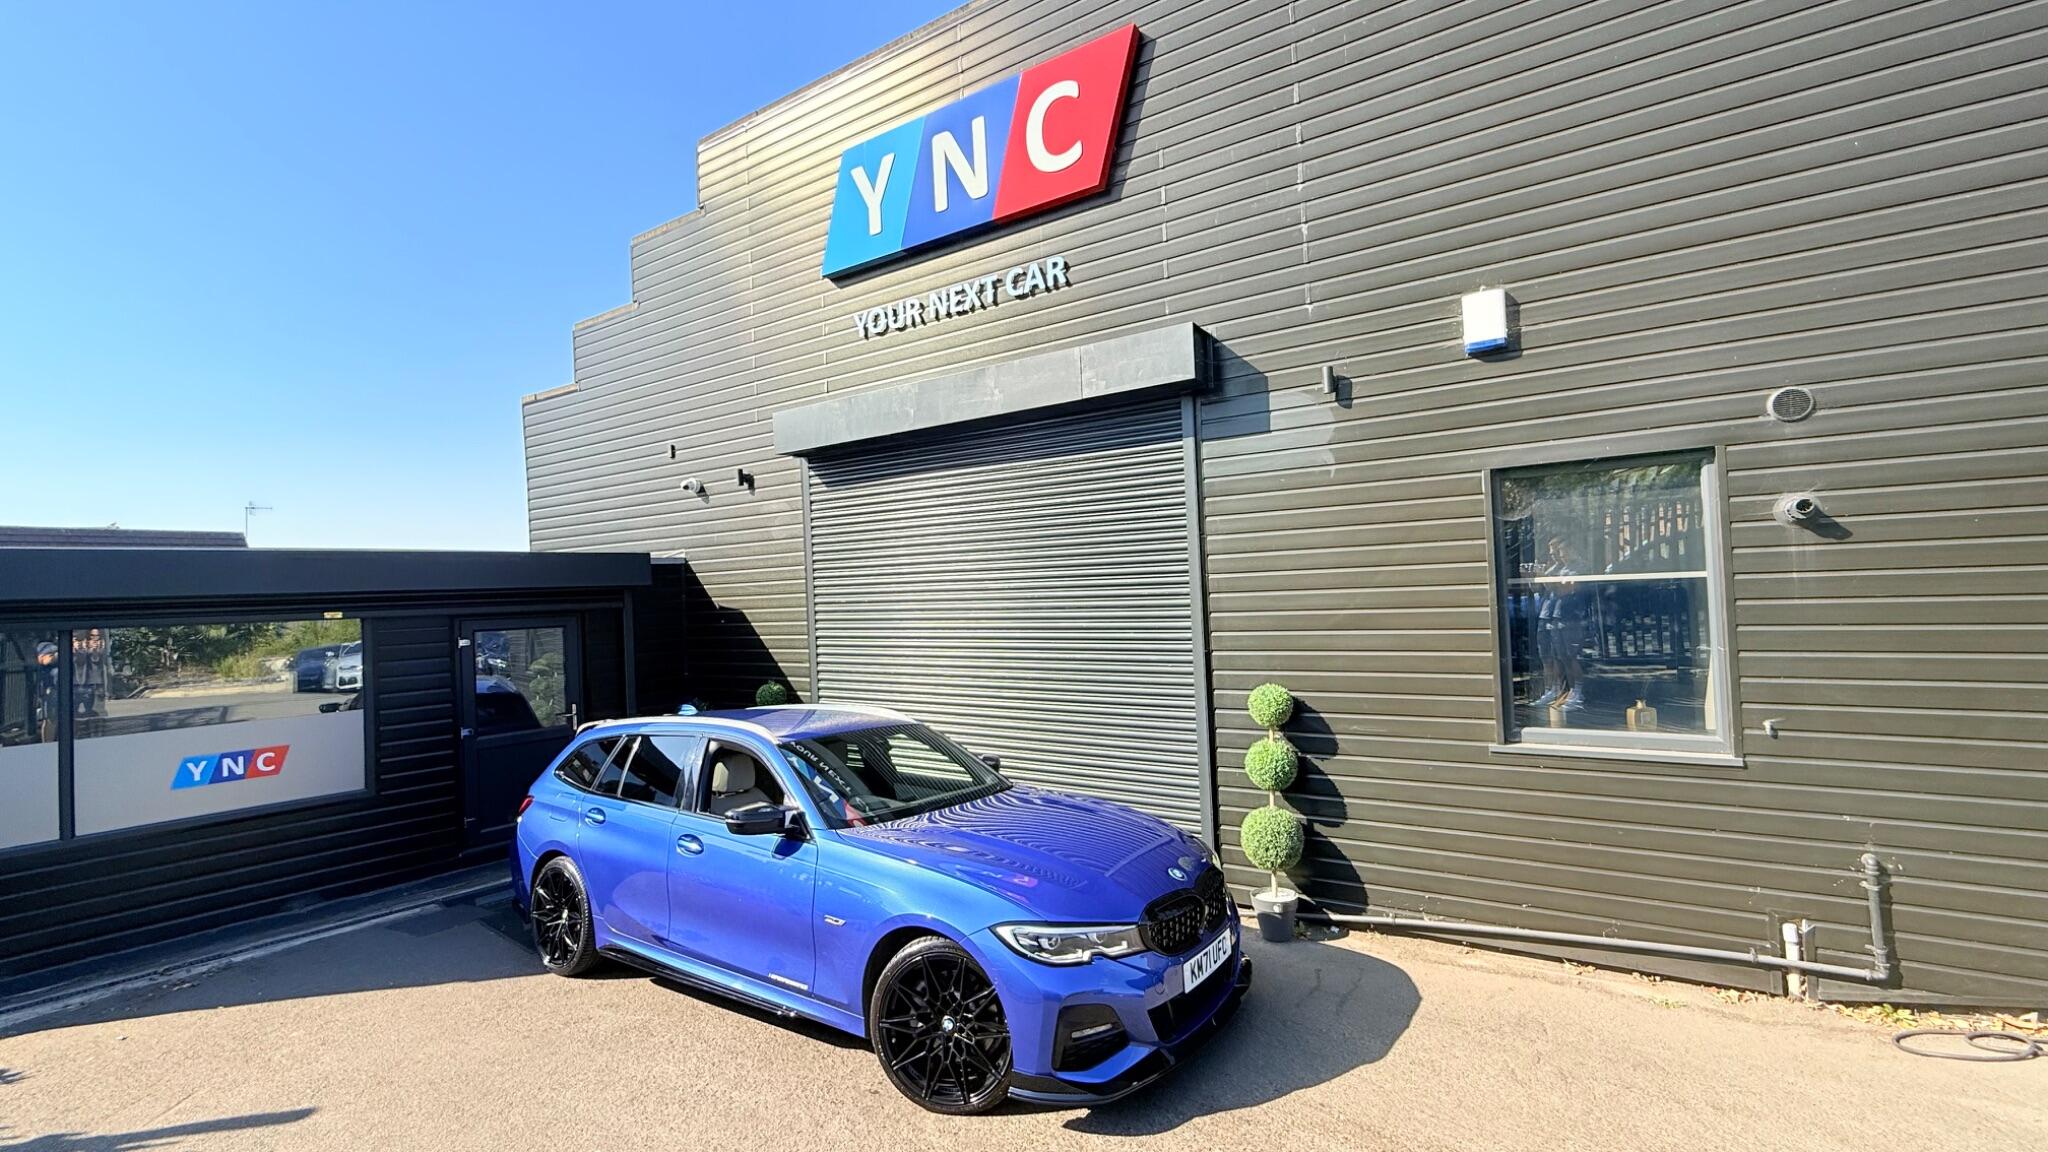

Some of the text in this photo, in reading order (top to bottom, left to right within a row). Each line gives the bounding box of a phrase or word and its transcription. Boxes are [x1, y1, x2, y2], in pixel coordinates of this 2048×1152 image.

[850, 80, 1083, 236] YNC
[854, 256, 1069, 338] YOUR NEXT CAR
[186, 752, 276, 781] YNC
